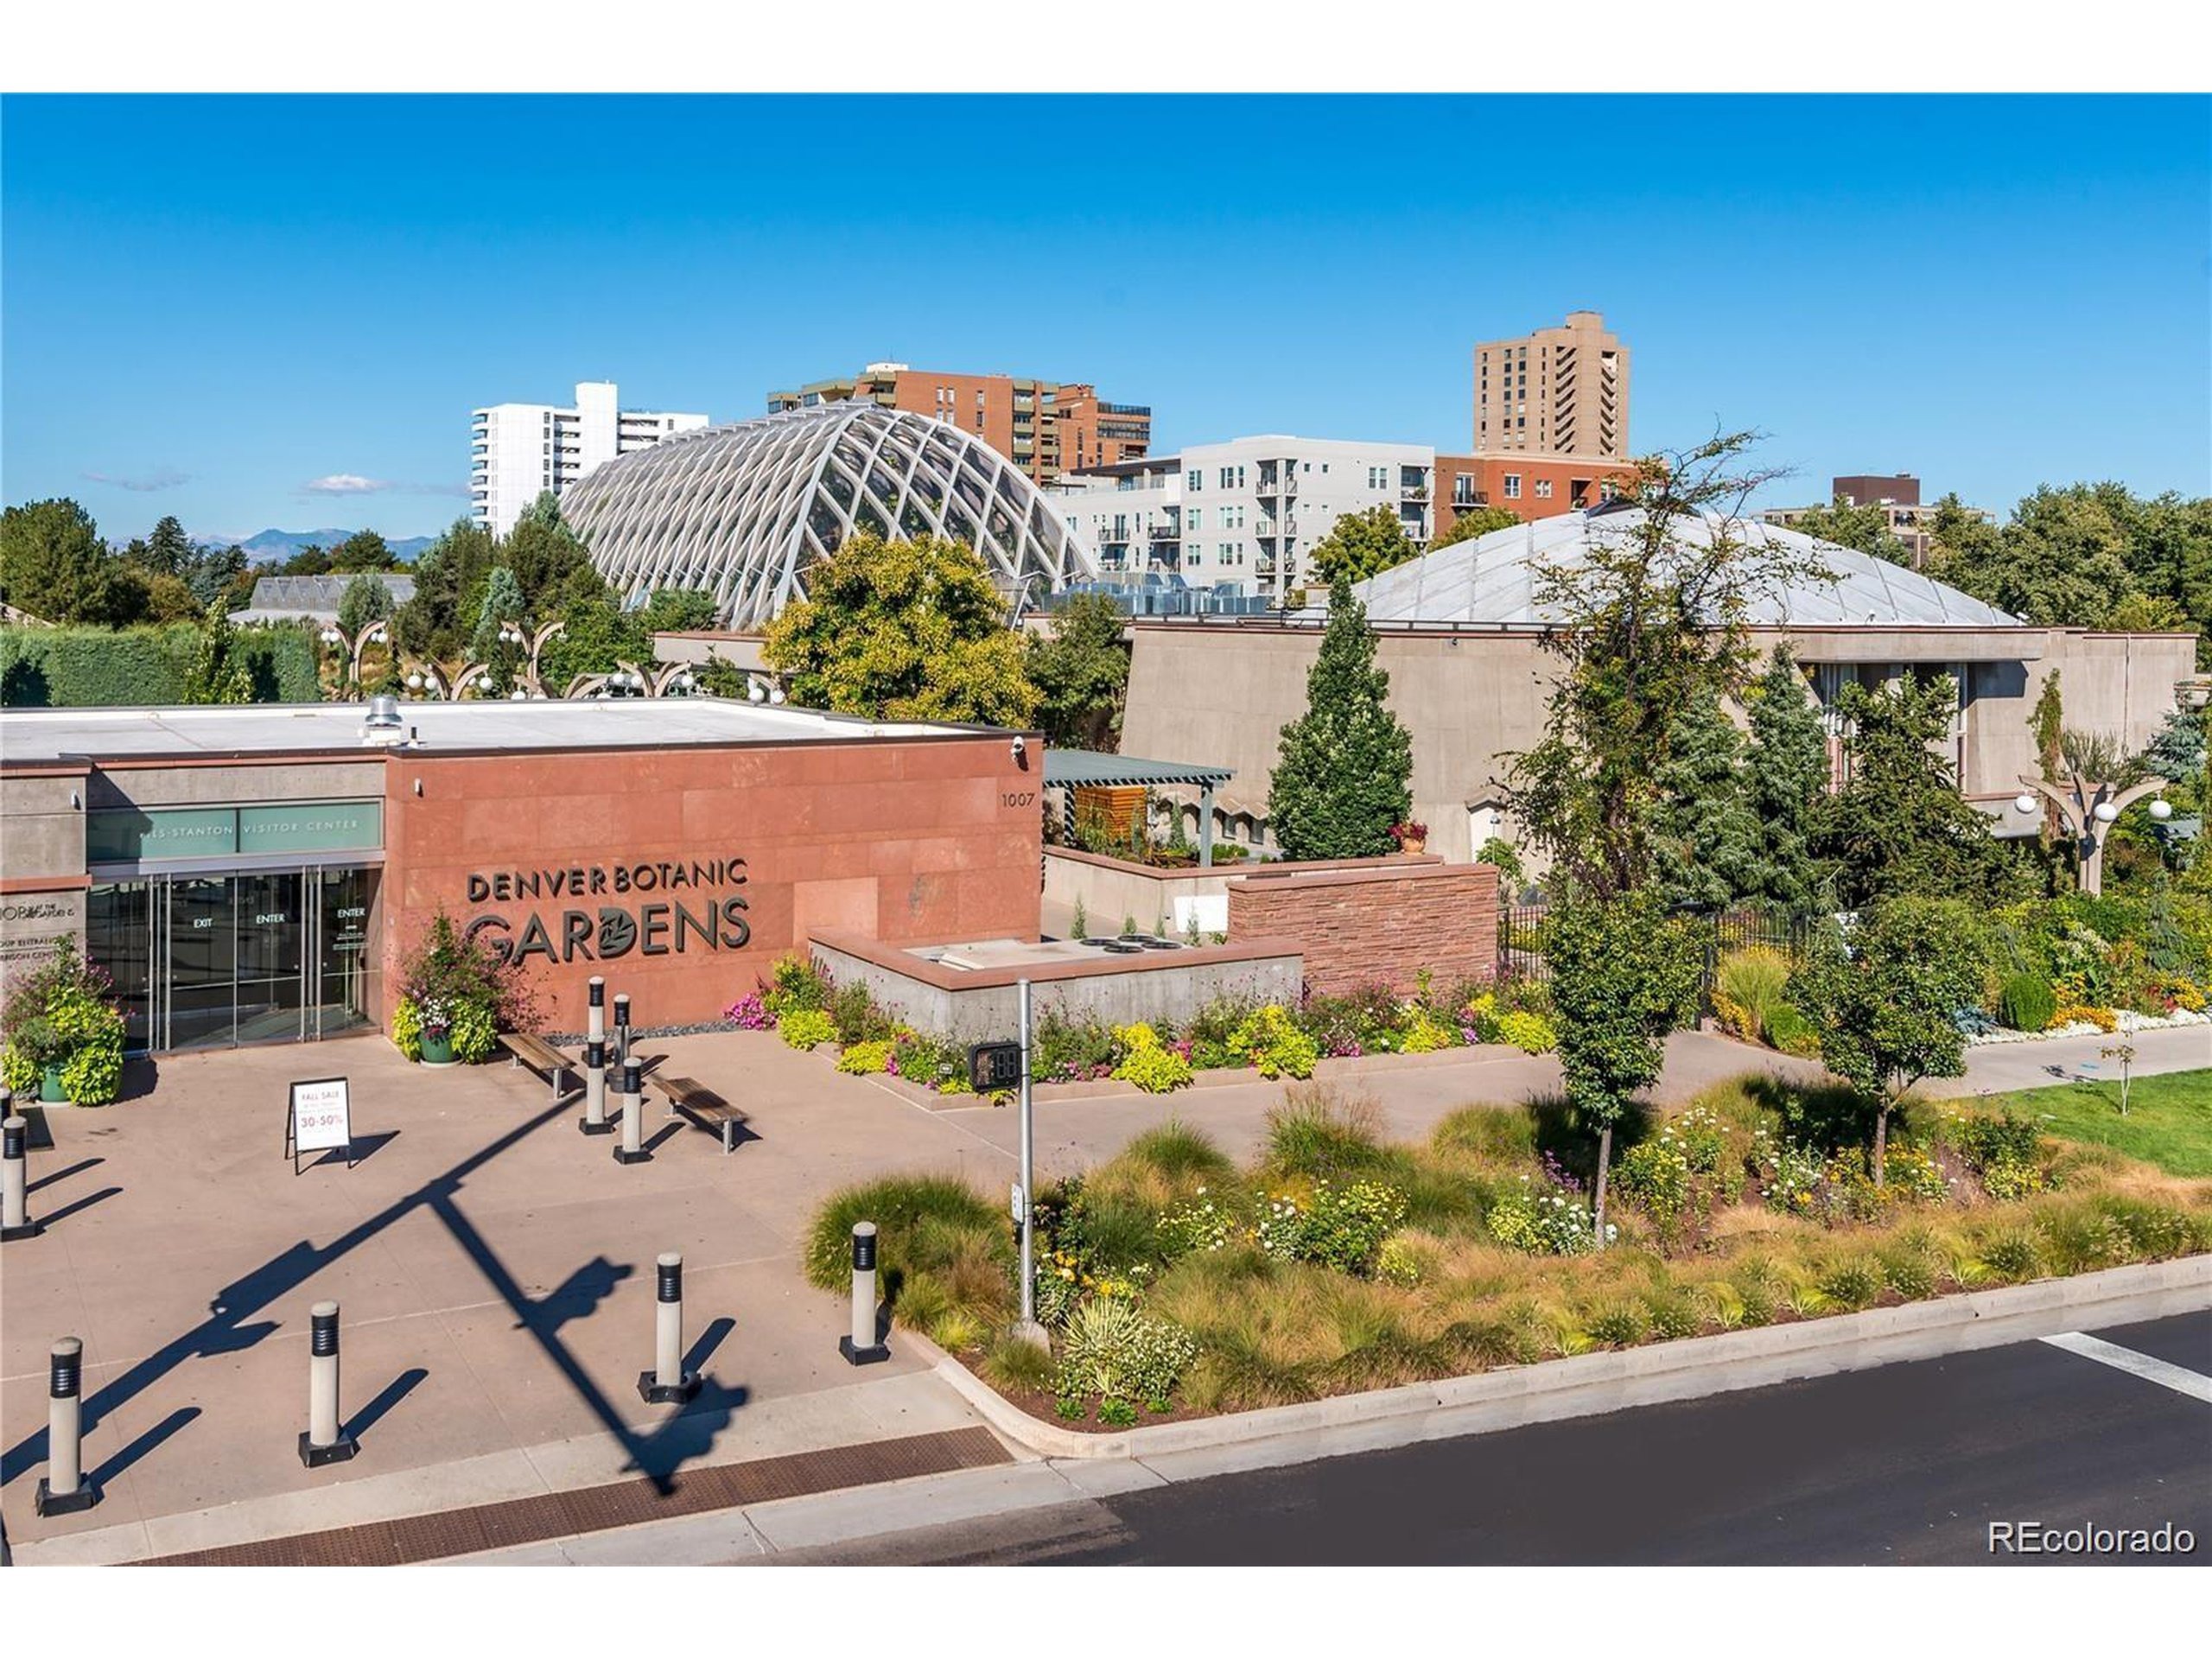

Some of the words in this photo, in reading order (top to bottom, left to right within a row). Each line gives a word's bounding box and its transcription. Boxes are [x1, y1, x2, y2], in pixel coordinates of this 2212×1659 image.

[1002, 792, 1035, 808] 1007
[243, 823, 300, 834] VISITOR
[306, 820, 358, 832] CENTER
[467, 867, 607, 901] DENVER
[613, 859, 748, 893] BOTANIC
[256, 913, 285, 925] ENTER
[337, 908, 365, 918] ENTER
[194, 918, 213, 928] EXIT
[466, 896, 750, 965] GARDENS
